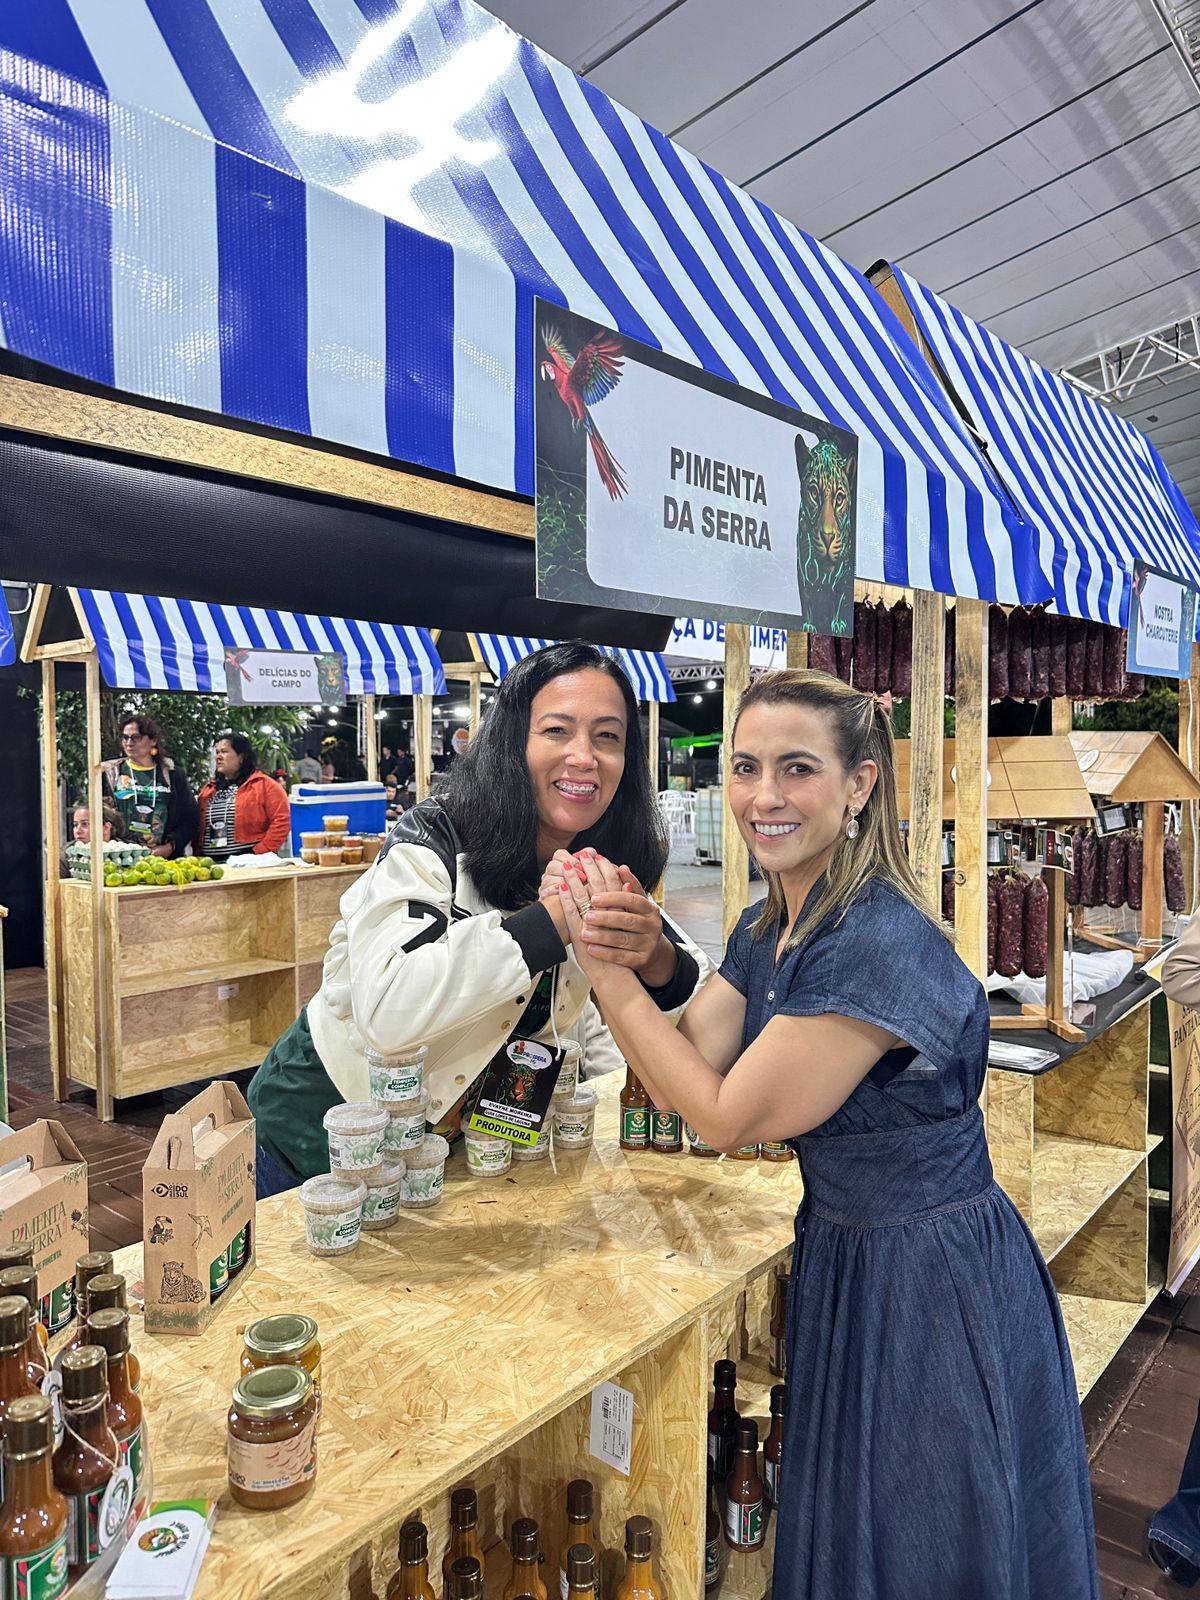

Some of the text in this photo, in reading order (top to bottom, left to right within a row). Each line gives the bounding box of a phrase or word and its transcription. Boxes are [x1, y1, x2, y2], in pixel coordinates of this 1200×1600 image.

[671, 446, 768, 506] PIMENTA
[663, 495, 772, 551] DA SERRA
[1154, 603, 1174, 623] NOSTRA
[703, 618, 725, 643] DE
[1145, 623, 1178, 643] CHARCUTERIE
[259, 667, 312, 678] DELÍCIAS DO
[271, 679, 302, 689] CAMPO
[488, 1102, 532, 1119] EVAYNE MOREIRA
[475, 1118, 531, 1142] PRODUTORA
[11, 1200, 66, 1244] PIMENTA
[32, 1223, 62, 1255] ERRA
